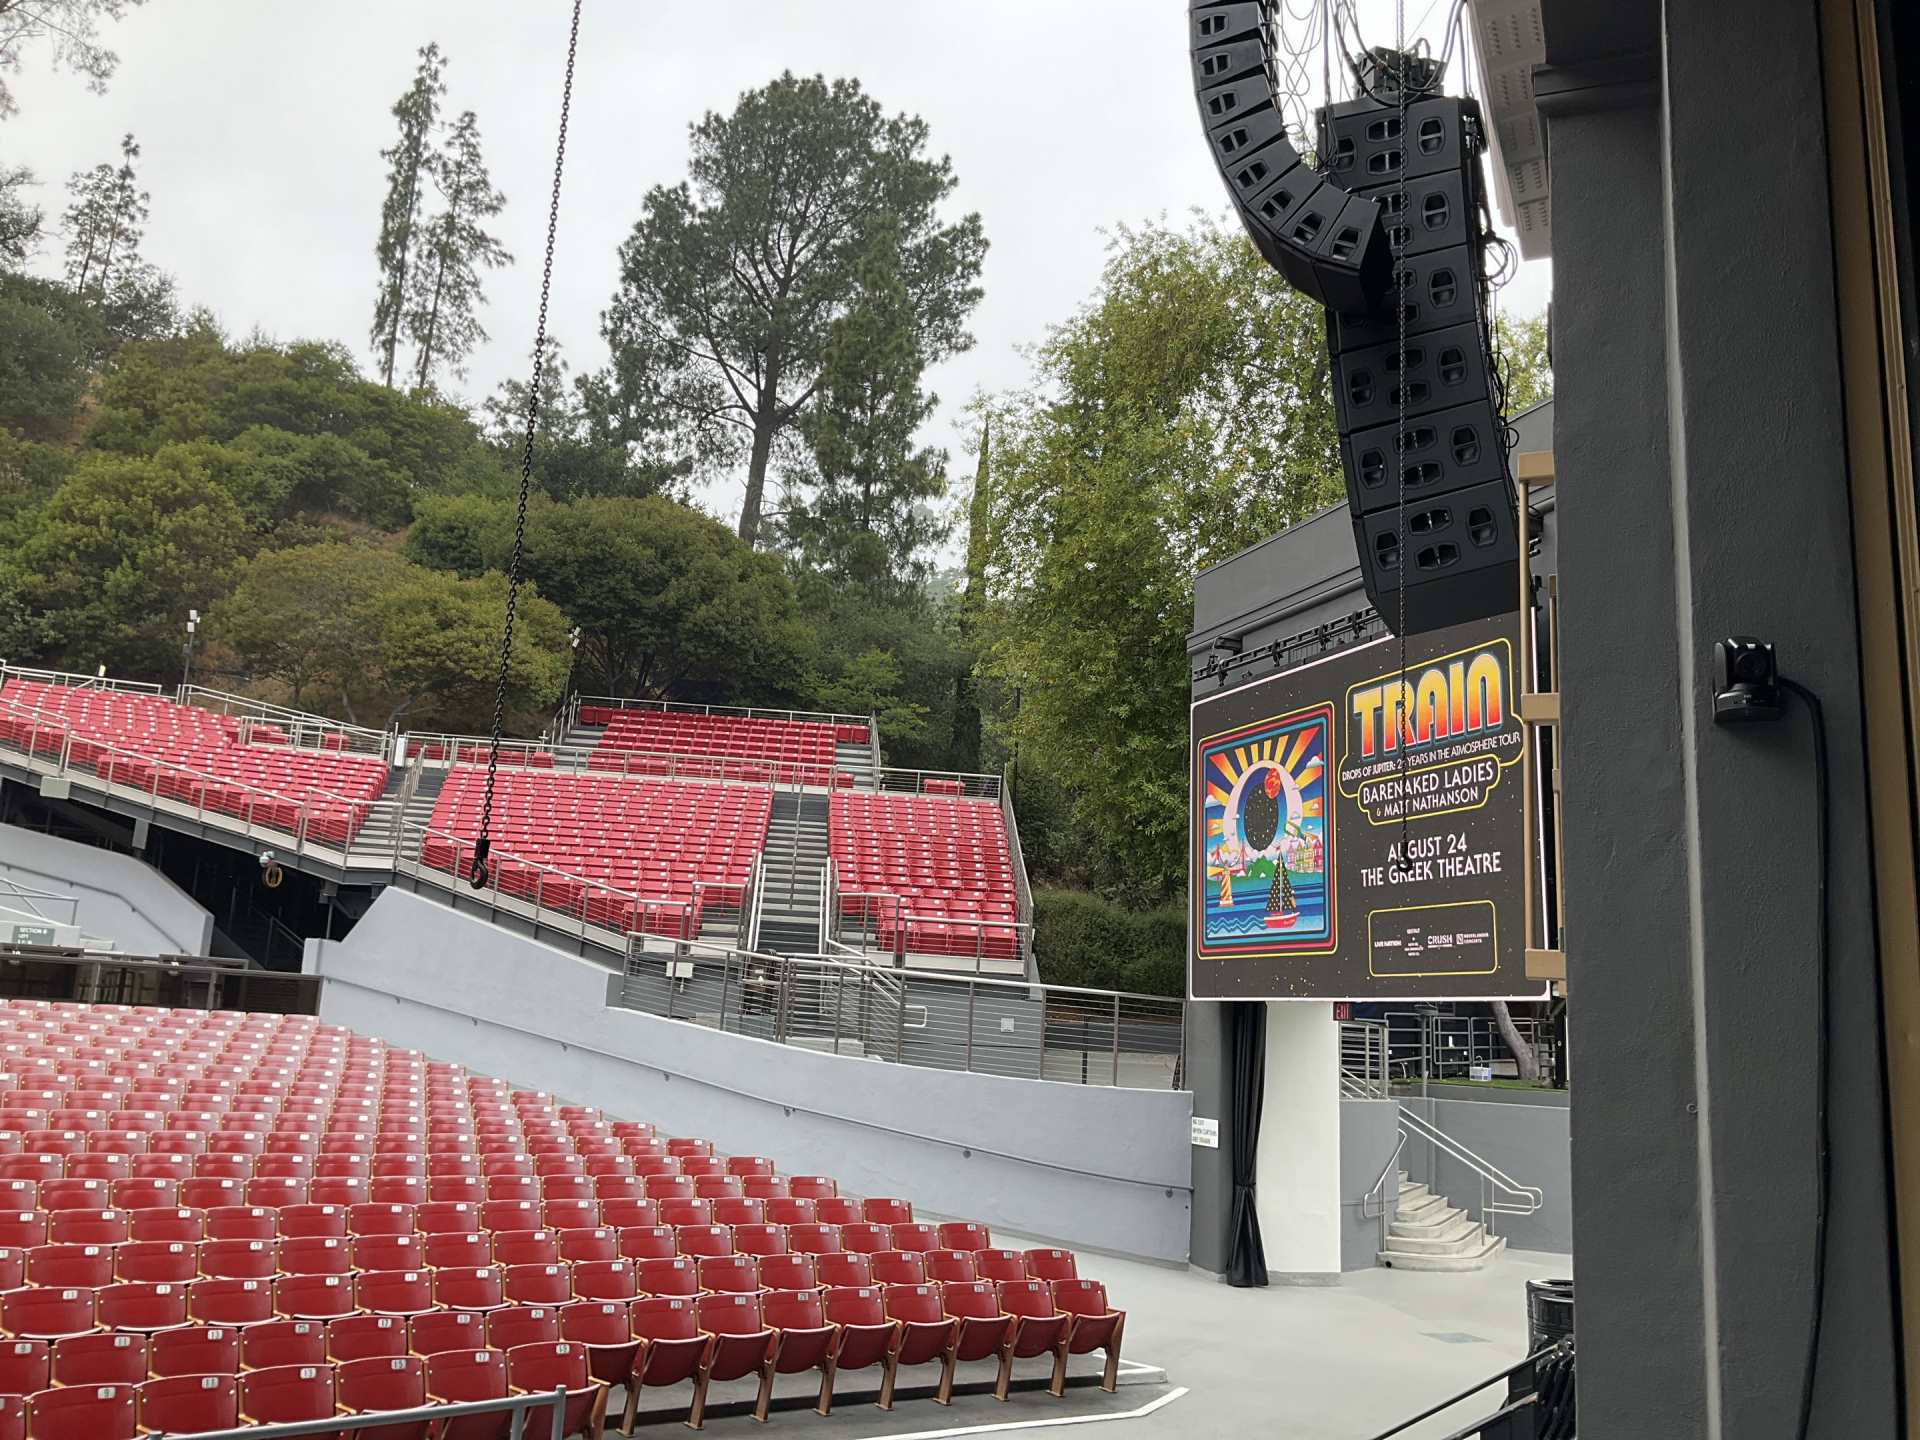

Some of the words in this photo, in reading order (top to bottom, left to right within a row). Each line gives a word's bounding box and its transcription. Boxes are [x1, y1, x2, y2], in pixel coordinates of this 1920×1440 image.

[1353, 653, 1501, 758] TRAIN
[1342, 768, 1361, 781] DROPS
[1362, 765, 1371, 776] OF
[1372, 761, 1395, 775] JUPITER:
[1407, 752, 1428, 766] YEARS
[1429, 751, 1437, 761] IN
[1437, 747, 1450, 760] THE
[1451, 736, 1497, 757] ATMOSPHERE
[1498, 731, 1521, 746] TOUR
[1363, 773, 1439, 804] BARENAKED
[1444, 761, 1493, 788] LADIES
[1384, 800, 1410, 816] MATT
[1413, 786, 1478, 811] NATHANSON
[1447, 832, 1467, 854] 24
[1361, 867, 1384, 887] THE
[1437, 851, 1502, 878] THEATRE
[1428, 934, 1452, 944] CRUSH
[1336, 1003, 1349, 1019] EXIT
[380, 1319, 389, 1327] 17
[478, 1353, 487, 1361] 17
[558, 1345, 567, 1353] 19
[303, 1369, 313, 1377] 13
[205, 1379, 215, 1387] 11
